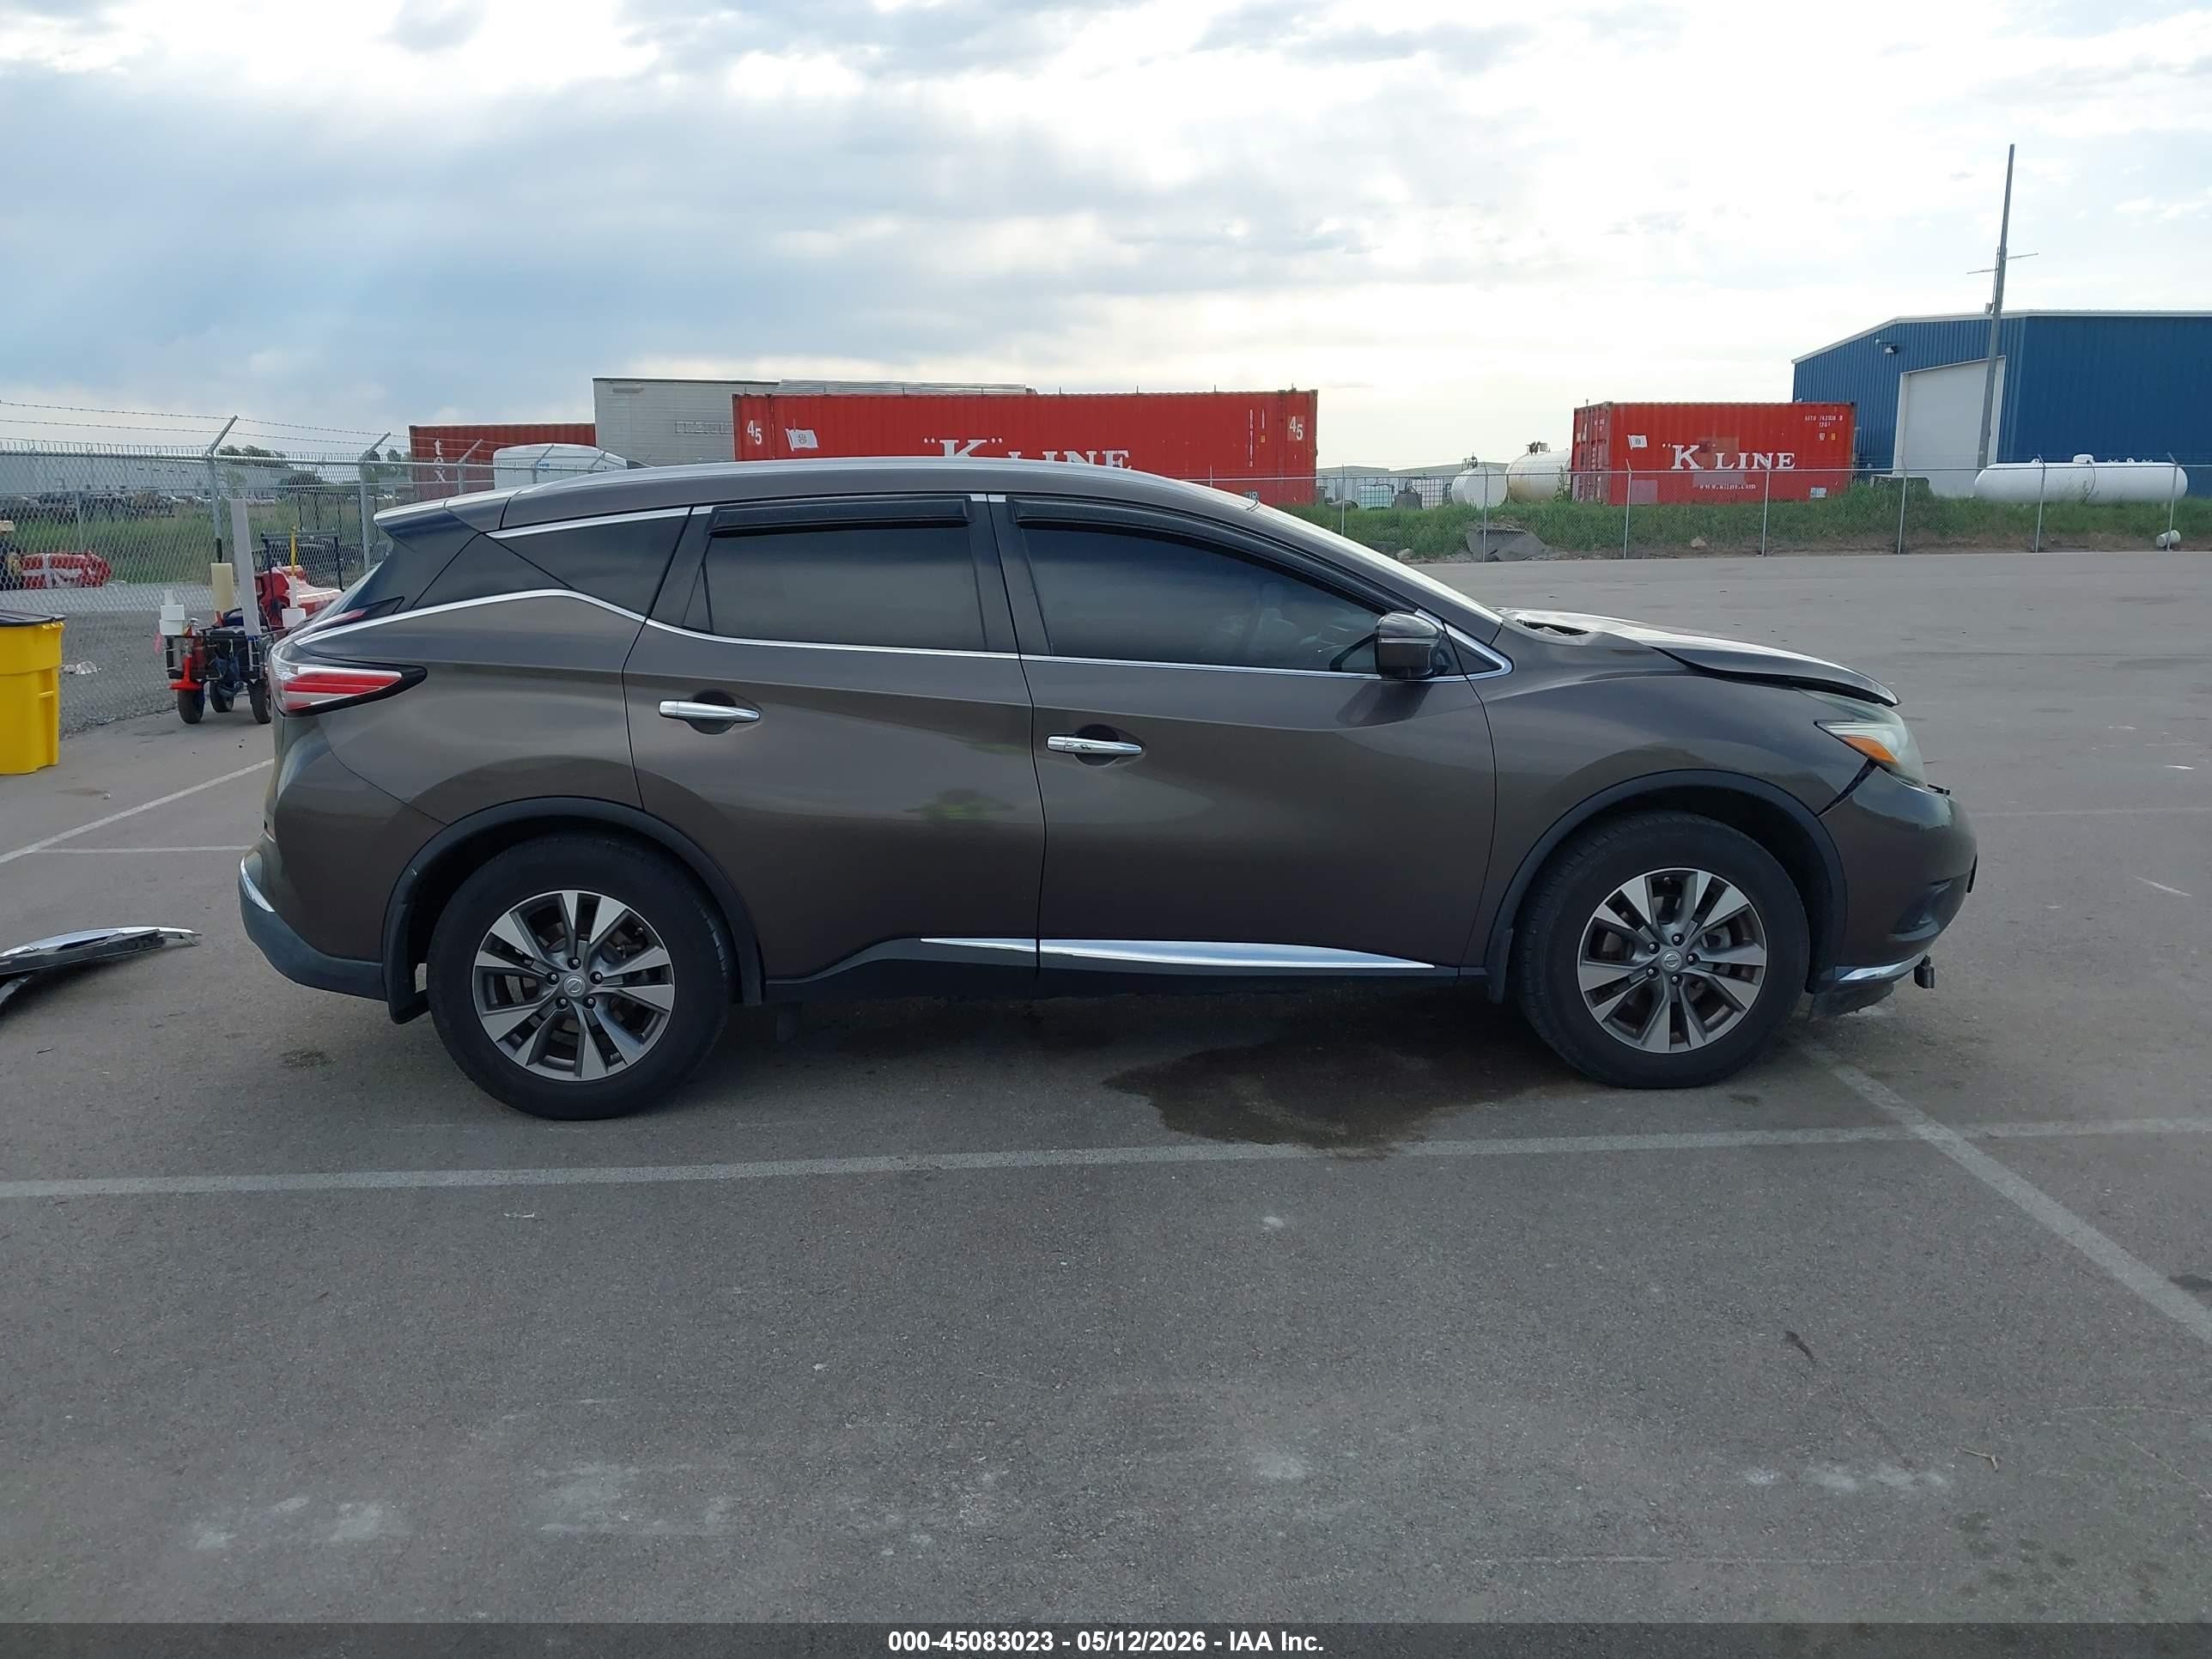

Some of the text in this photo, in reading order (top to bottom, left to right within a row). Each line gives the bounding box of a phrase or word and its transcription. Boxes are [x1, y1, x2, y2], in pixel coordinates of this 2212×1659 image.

[747, 420, 763, 445] 45
[1289, 416, 1304, 441] 45
[1715, 452, 1796, 470] LINE
